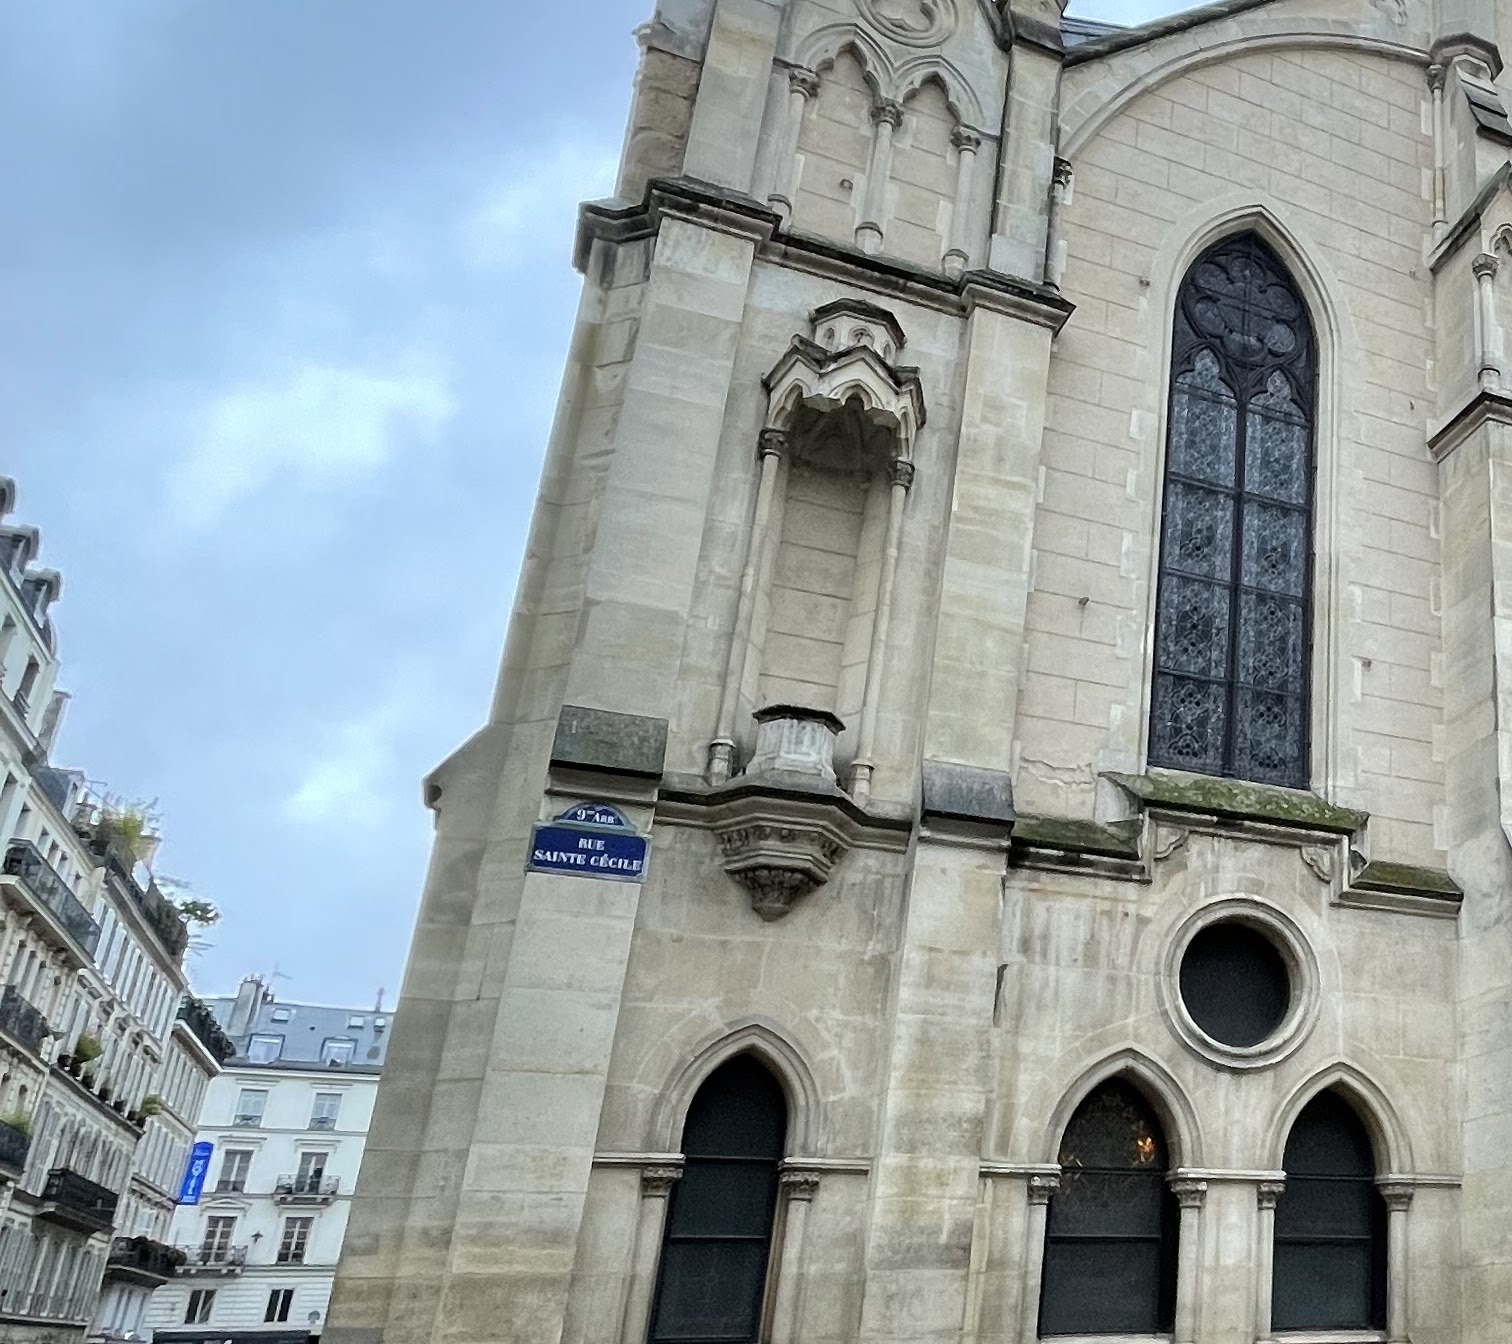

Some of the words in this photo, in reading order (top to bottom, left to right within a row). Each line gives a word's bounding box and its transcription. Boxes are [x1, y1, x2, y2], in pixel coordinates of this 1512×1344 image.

[578, 838, 605, 850] RUE
[533, 849, 587, 865] SAINTE
[590, 854, 642, 871] CÉCILE
